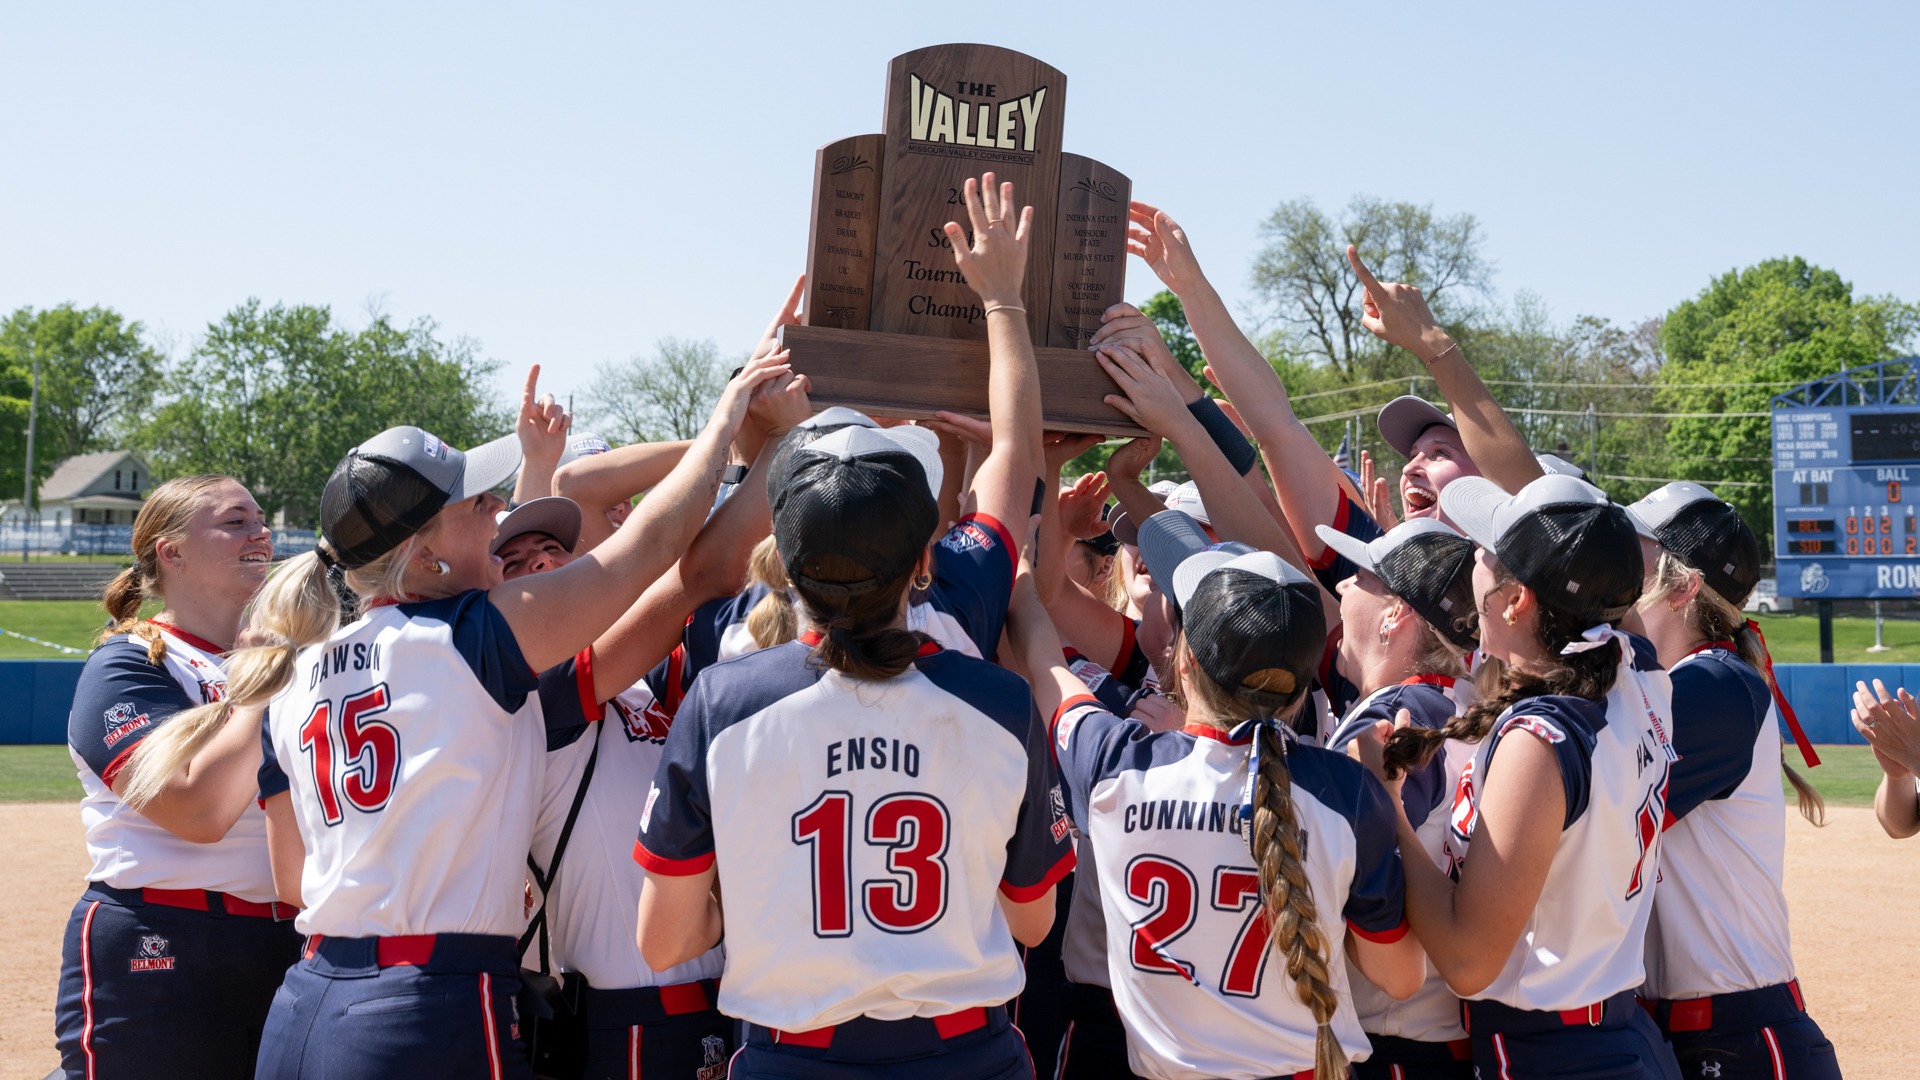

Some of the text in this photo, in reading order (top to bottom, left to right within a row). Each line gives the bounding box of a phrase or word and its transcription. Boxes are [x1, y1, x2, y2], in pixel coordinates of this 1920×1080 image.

[956, 81, 997, 98] THE
[909, 72, 1048, 152] VALLEY
[909, 144, 1035, 164] MISSOURI VALLEY CONFERENCE
[836, 190, 865, 202] BELMONT
[835, 209, 862, 220] BRADLEY
[1066, 214, 1119, 224] INDIANA STATE
[836, 228, 857, 238] DRAKE
[1075, 229, 1108, 238] MISSOURI
[1080, 239, 1101, 247] STATE
[827, 246, 863, 257] EVANSVILLE
[1063, 253, 1115, 263] MURRAY STATE
[838, 266, 850, 275] UIC
[1081, 268, 1095, 277] UNI
[820, 282, 865, 296] ILLINOIS STATE
[1068, 282, 1105, 291] SOUTHERN
[1072, 291, 1101, 300] ILLINOIS
[1792, 469, 1834, 483] AT BAT
[1876, 468, 1910, 482] BALL
[1887, 481, 1901, 503] 0
[1848, 504, 1915, 517] 1 2 3 4
[1798, 519, 1822, 533] BEL
[1846, 517, 1859, 535] 0
[1863, 517, 1876, 535] 0
[1880, 516, 1892, 534] 2
[1800, 536, 1918, 555] SIU 0 0 0 2
[1877, 564, 1920, 589] RON
[309, 642, 381, 693] DAWSON
[104, 713, 151, 747] BELMONT
[299, 681, 402, 828] 15
[827, 736, 920, 779] ENSIO
[791, 789, 952, 939] 13
[1125, 853, 1278, 1000] 27
[130, 956, 175, 972] BELMONT
